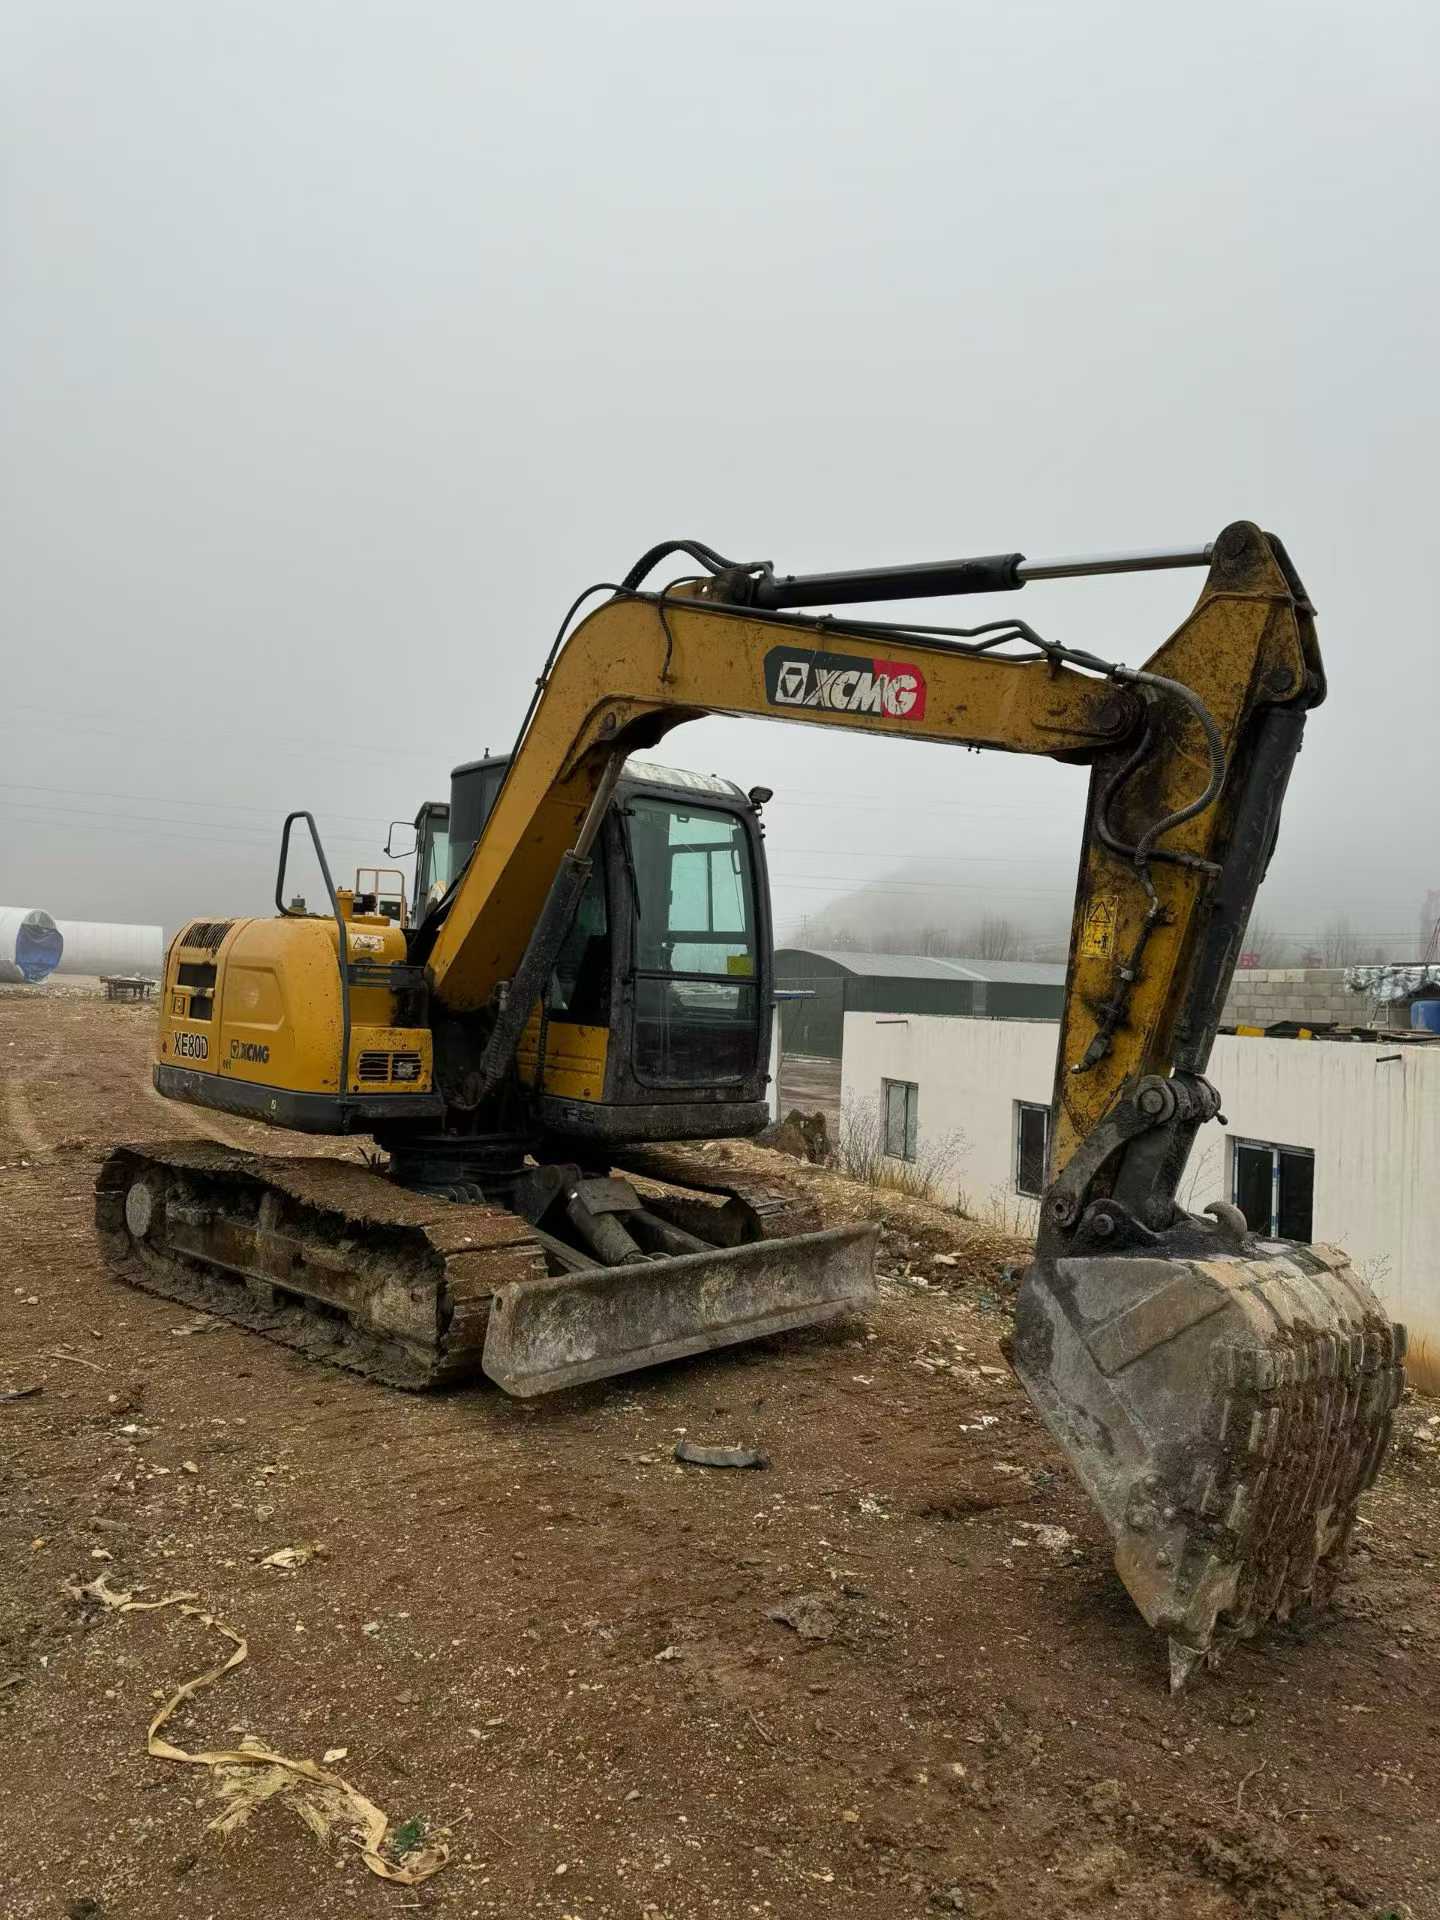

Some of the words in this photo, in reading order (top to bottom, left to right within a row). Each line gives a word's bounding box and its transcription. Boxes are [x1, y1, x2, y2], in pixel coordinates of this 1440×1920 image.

[803, 668, 918, 715] XCMG
[174, 1031, 209, 1060] XE80D
[241, 1042, 270, 1064] XCMG
